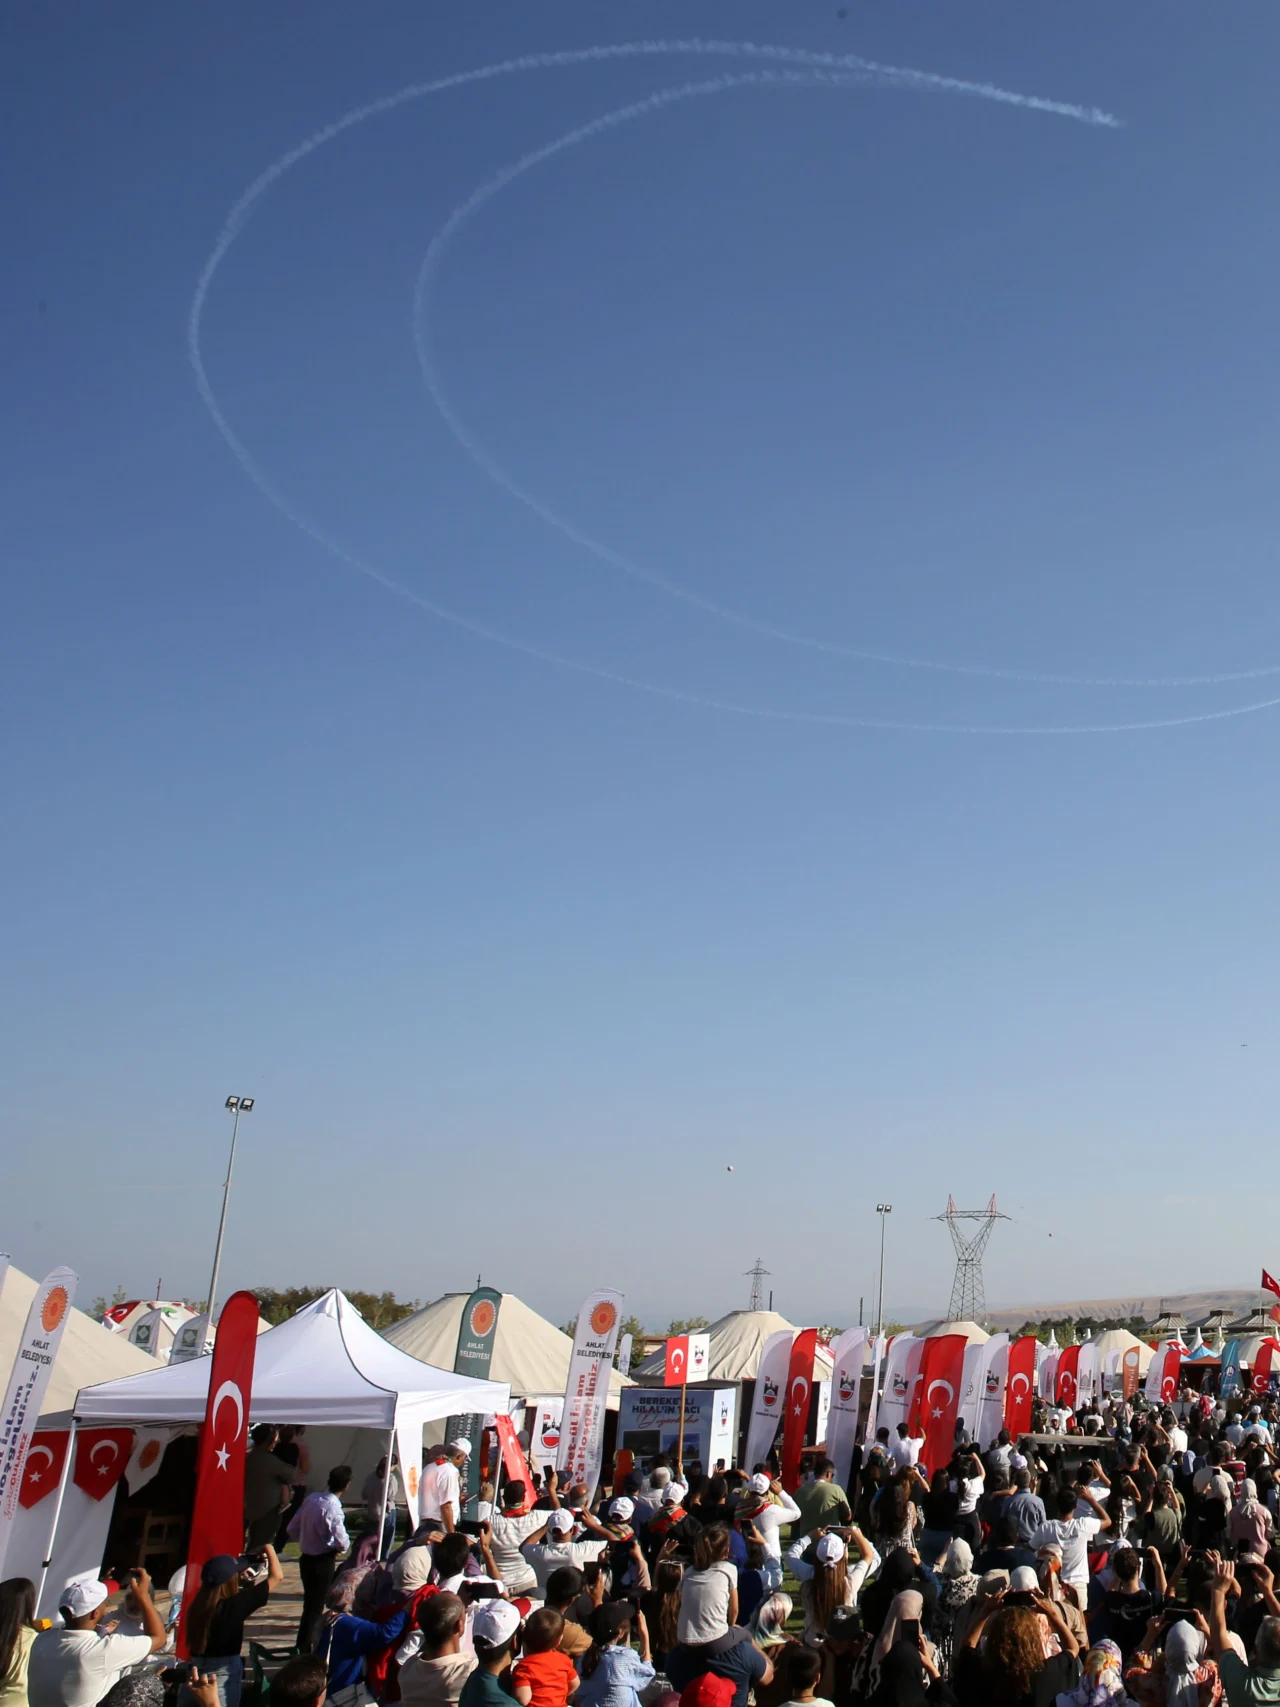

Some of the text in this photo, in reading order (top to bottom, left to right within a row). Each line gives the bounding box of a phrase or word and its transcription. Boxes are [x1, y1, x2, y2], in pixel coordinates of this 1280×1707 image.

[32, 1339, 50, 1350] AHLAT
[585, 1341, 605, 1349] AHLAT
[21, 1349, 52, 1365] BELEDİYESİ
[577, 1349, 612, 1359] BELEDİYESİ
[639, 1397, 695, 1406] BEREKELİ
